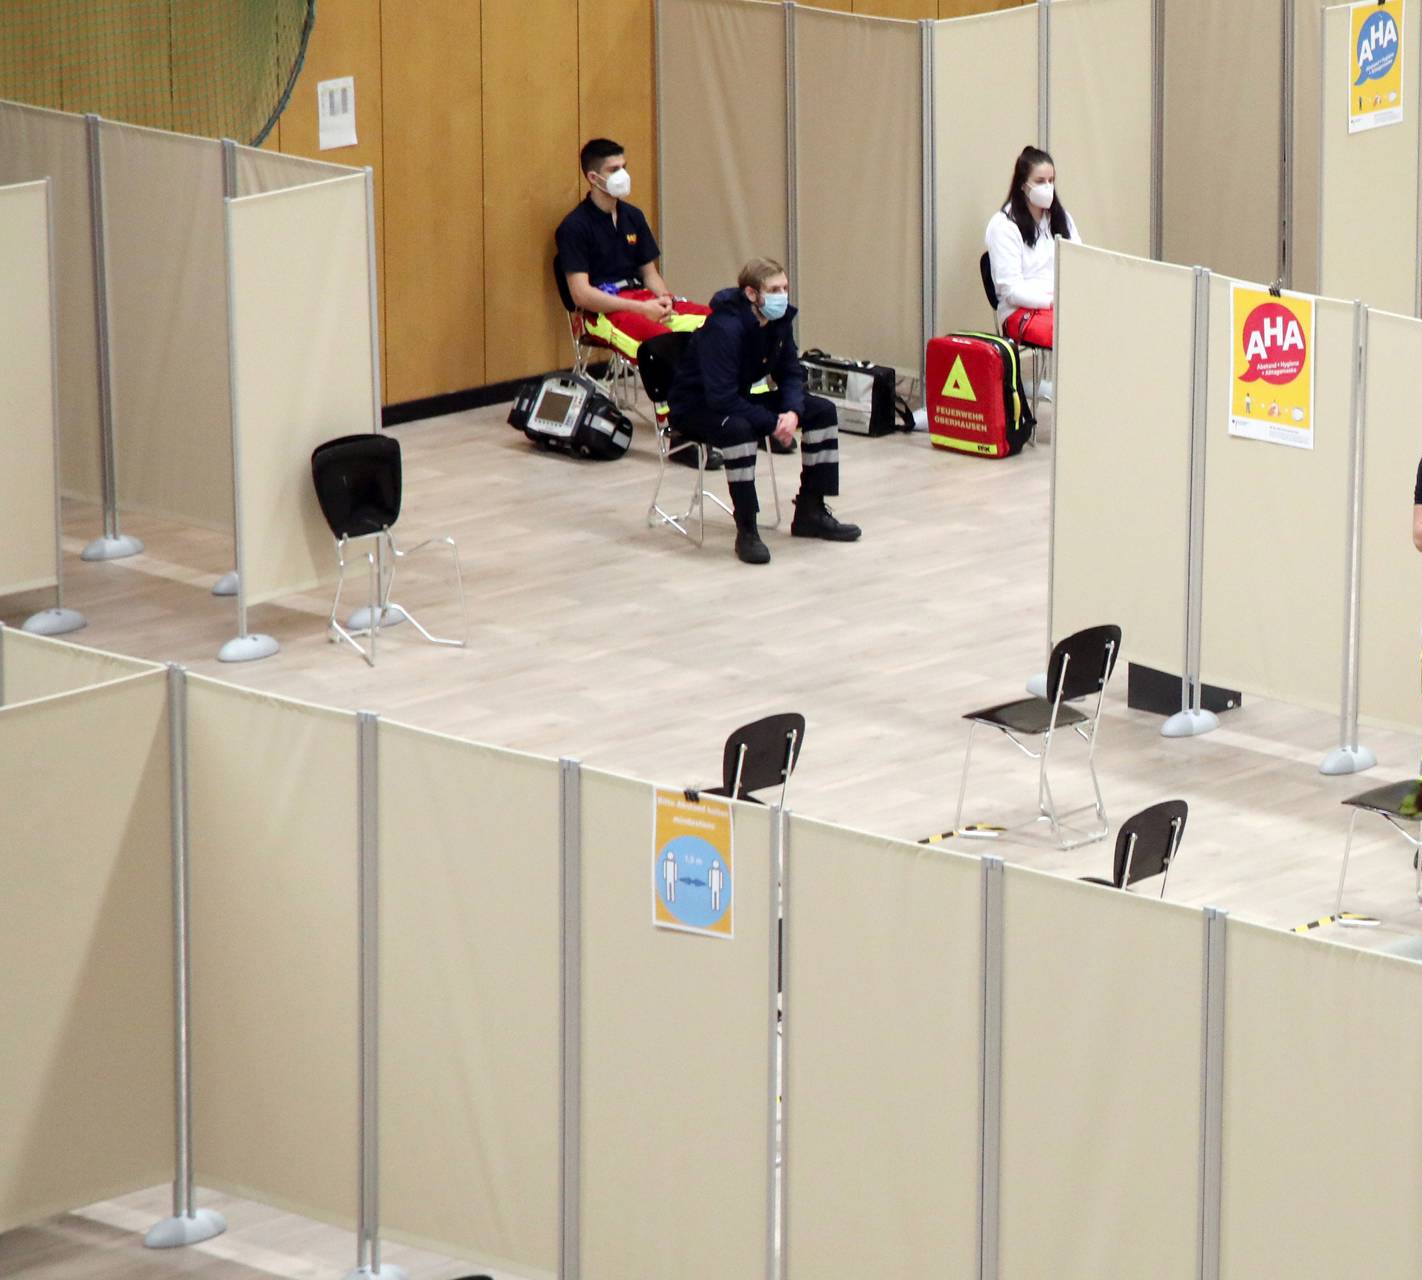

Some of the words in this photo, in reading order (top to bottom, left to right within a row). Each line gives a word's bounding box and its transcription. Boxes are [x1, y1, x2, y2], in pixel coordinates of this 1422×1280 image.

[1359, 19, 1398, 67] AHA
[1246, 316, 1304, 360] AHA
[934, 415, 988, 433] OBERHAUSEN
[936, 405, 984, 422] FEUERWEHR
